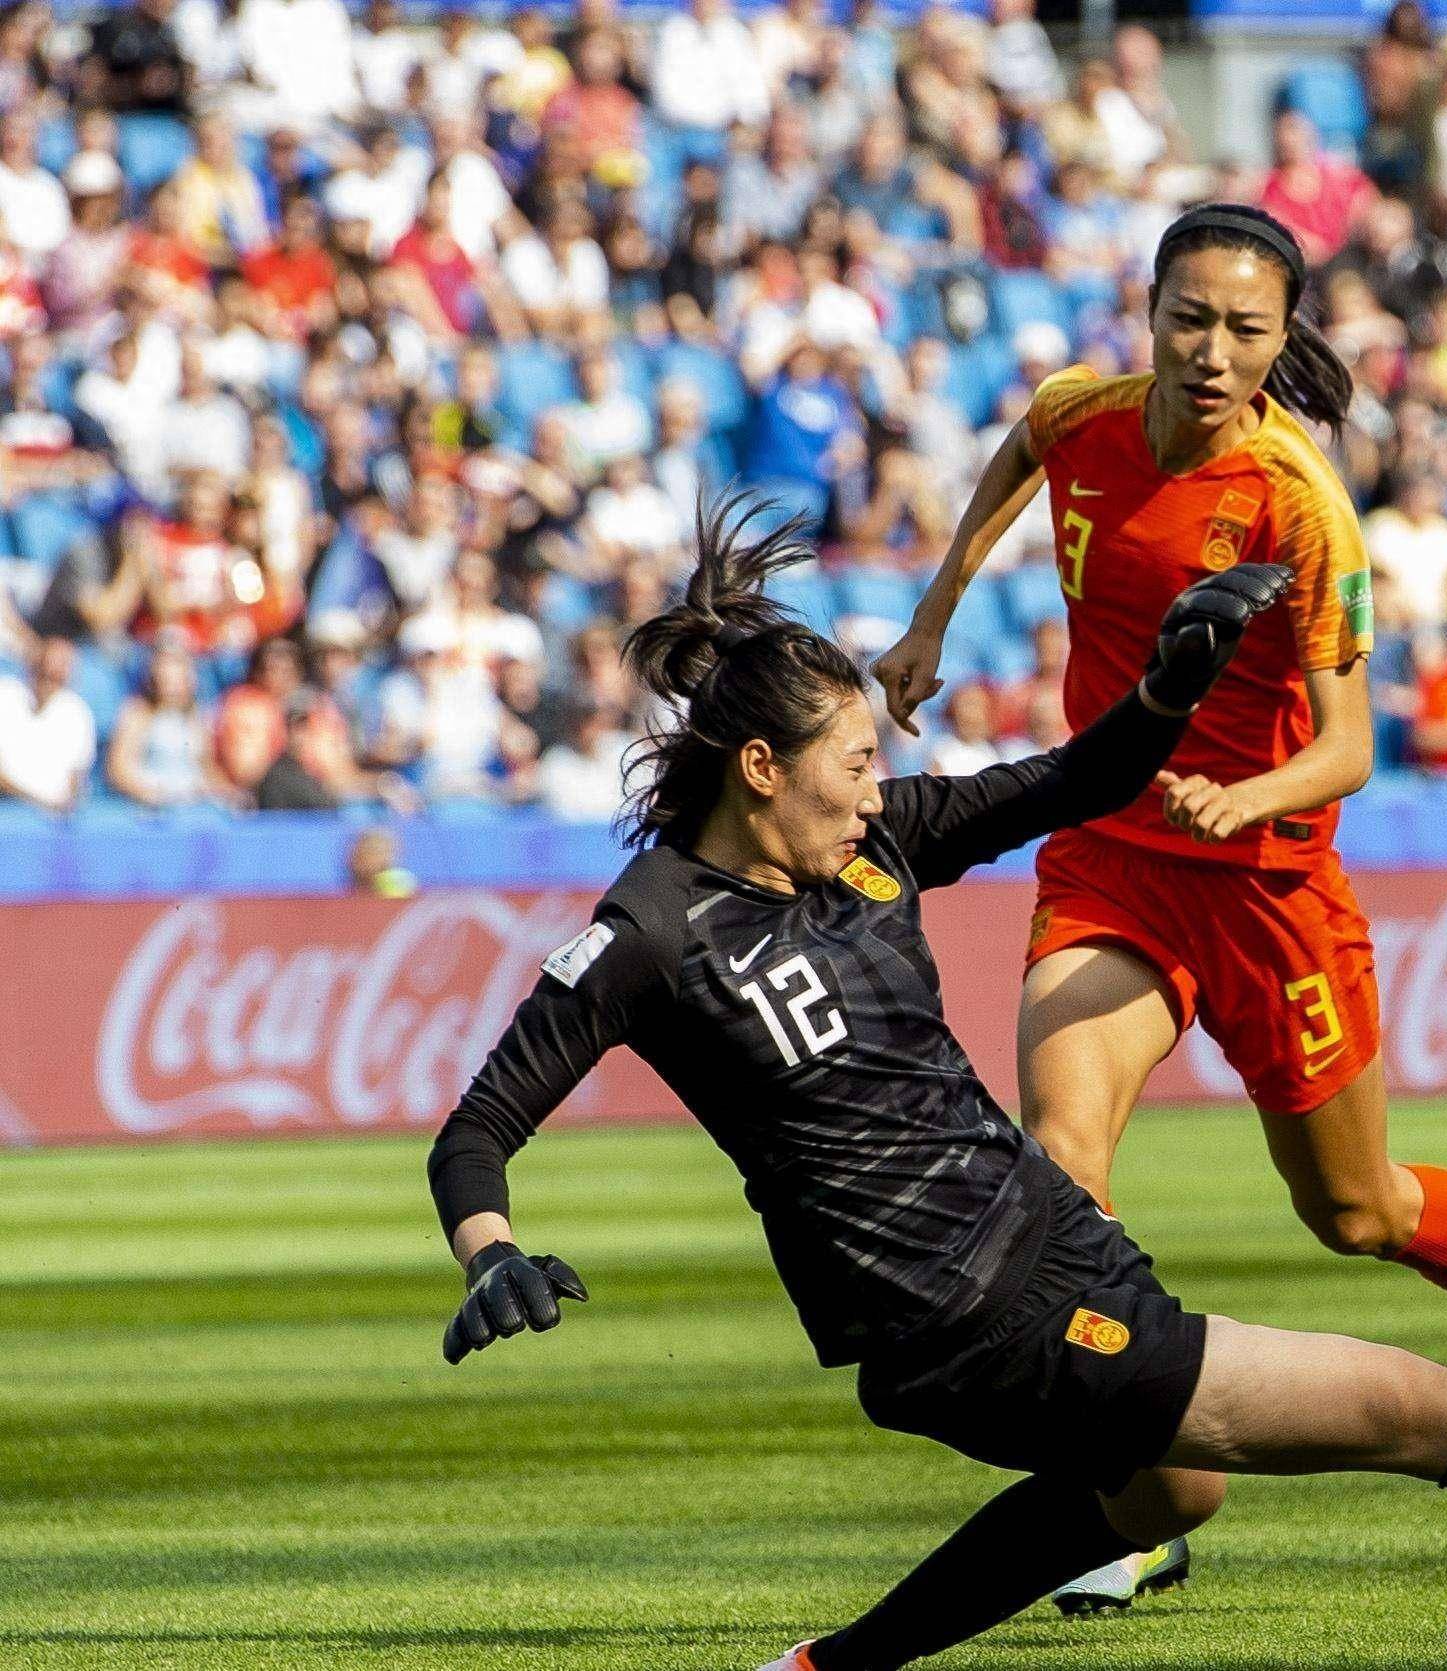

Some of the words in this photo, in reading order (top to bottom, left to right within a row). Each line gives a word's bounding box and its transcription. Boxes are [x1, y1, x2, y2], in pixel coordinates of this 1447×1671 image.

[1060, 509, 1093, 600] 3
[97, 888, 592, 1135] Coca-Col
[739, 954, 848, 1067] 12
[1285, 972, 1343, 1055] 3
